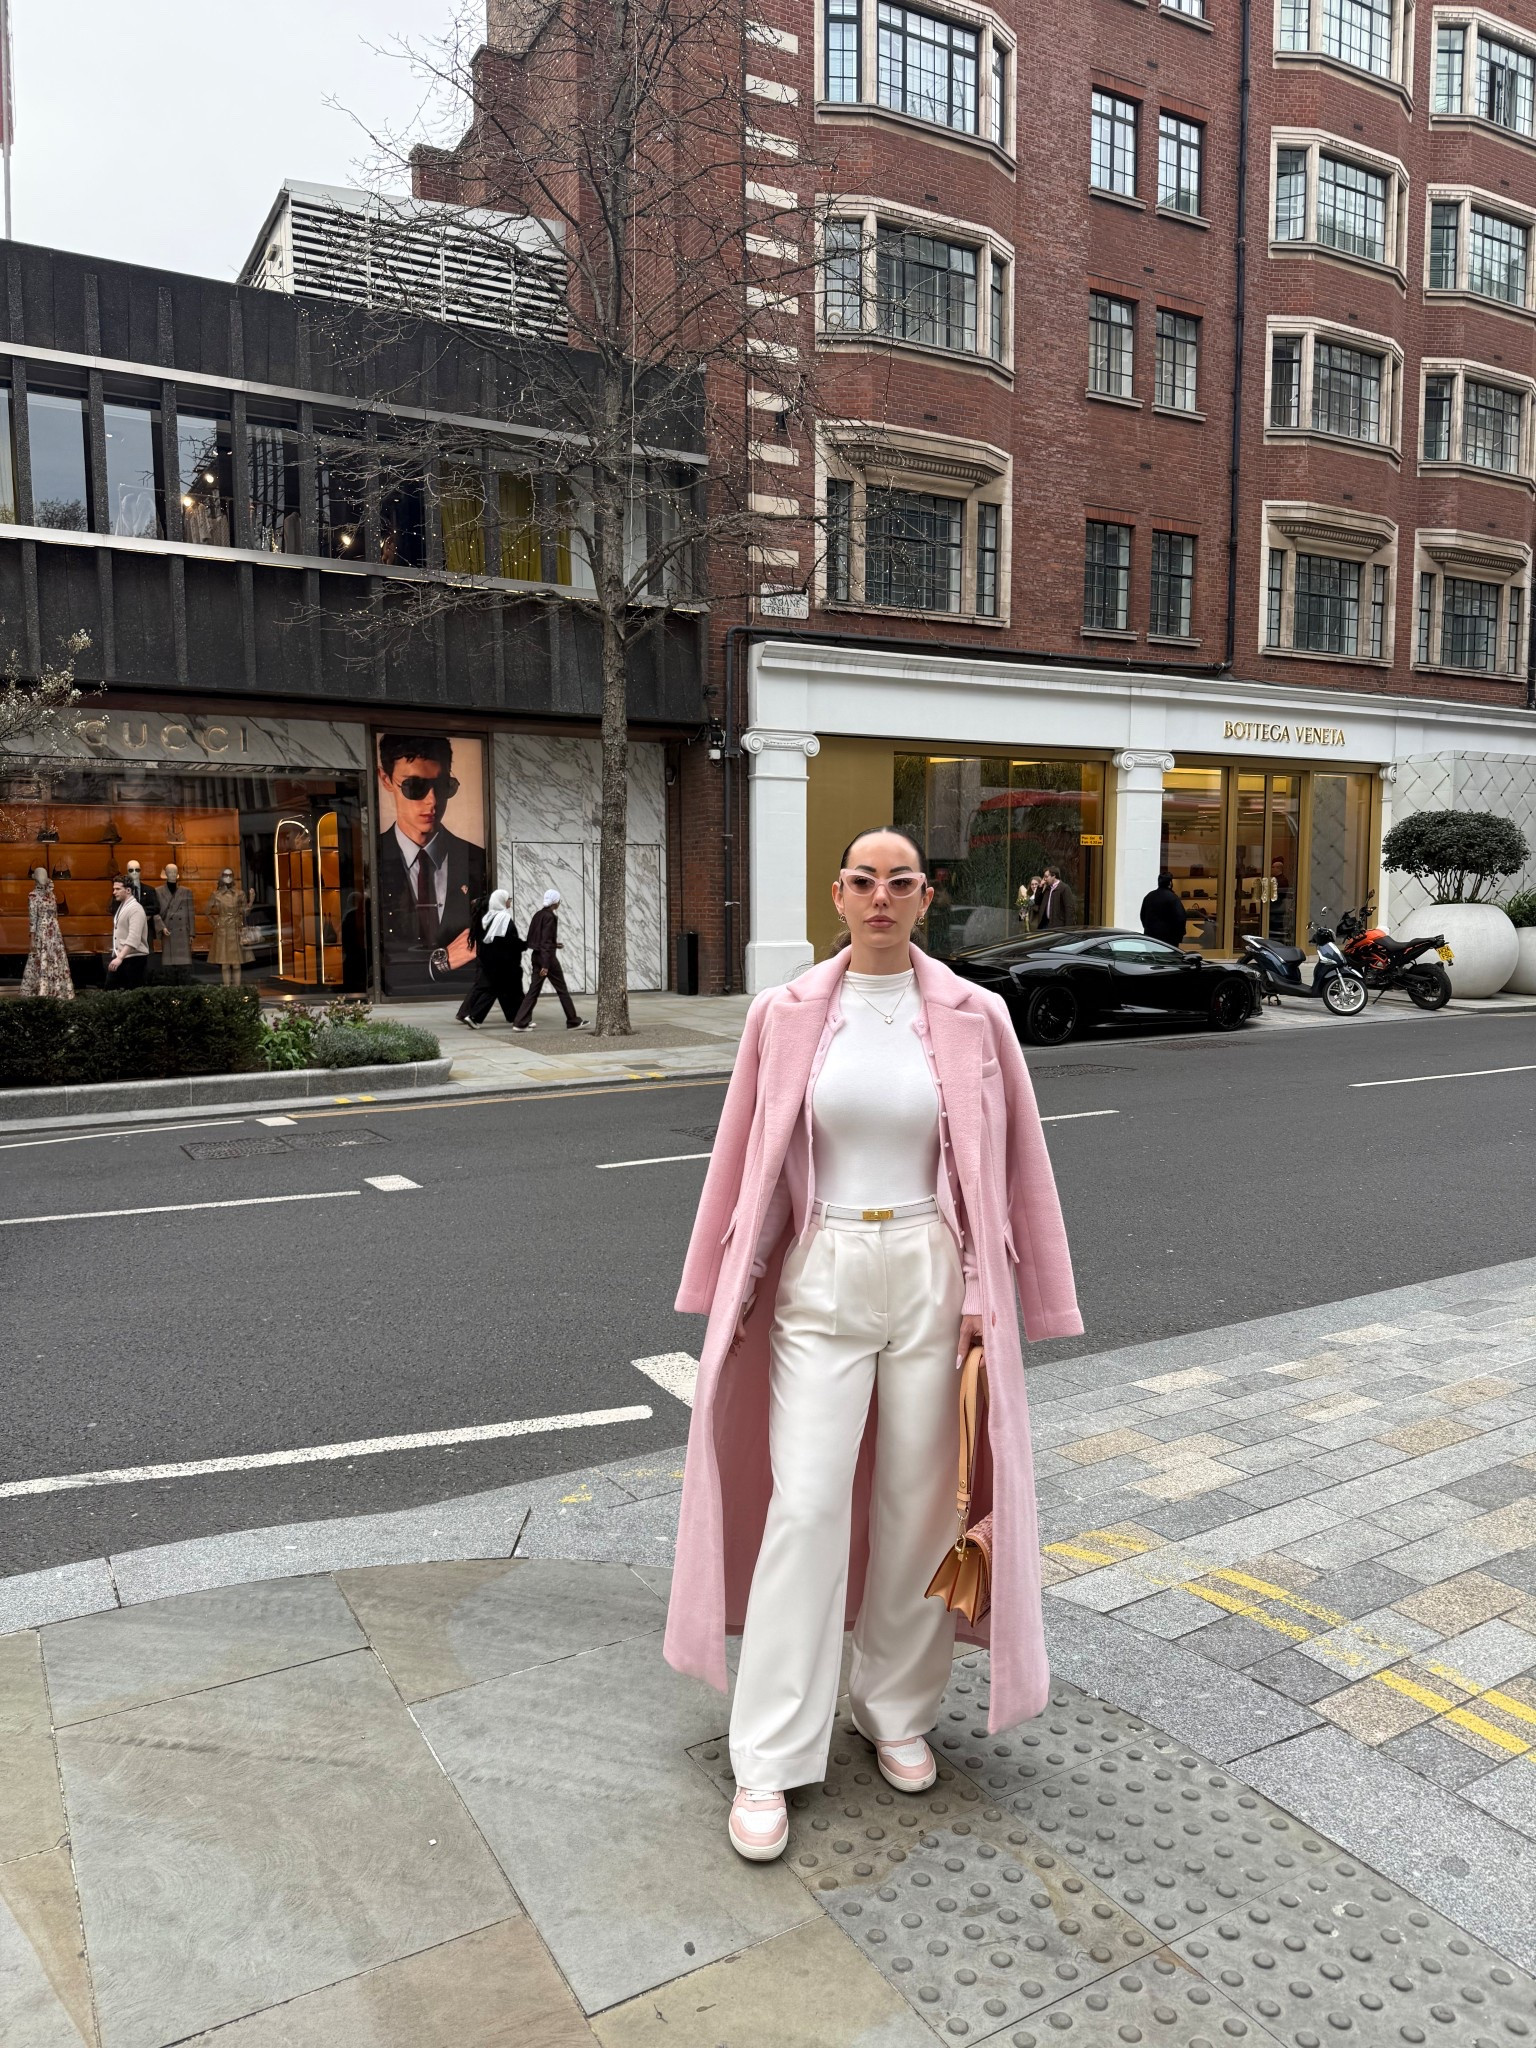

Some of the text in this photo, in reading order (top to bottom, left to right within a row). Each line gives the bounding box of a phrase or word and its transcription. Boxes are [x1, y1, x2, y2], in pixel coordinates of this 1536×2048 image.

[761, 605, 791, 616] STREET
[83, 720, 249, 753] GUCCI
[1223, 720, 1346, 746] BOTTEGA VENETA
